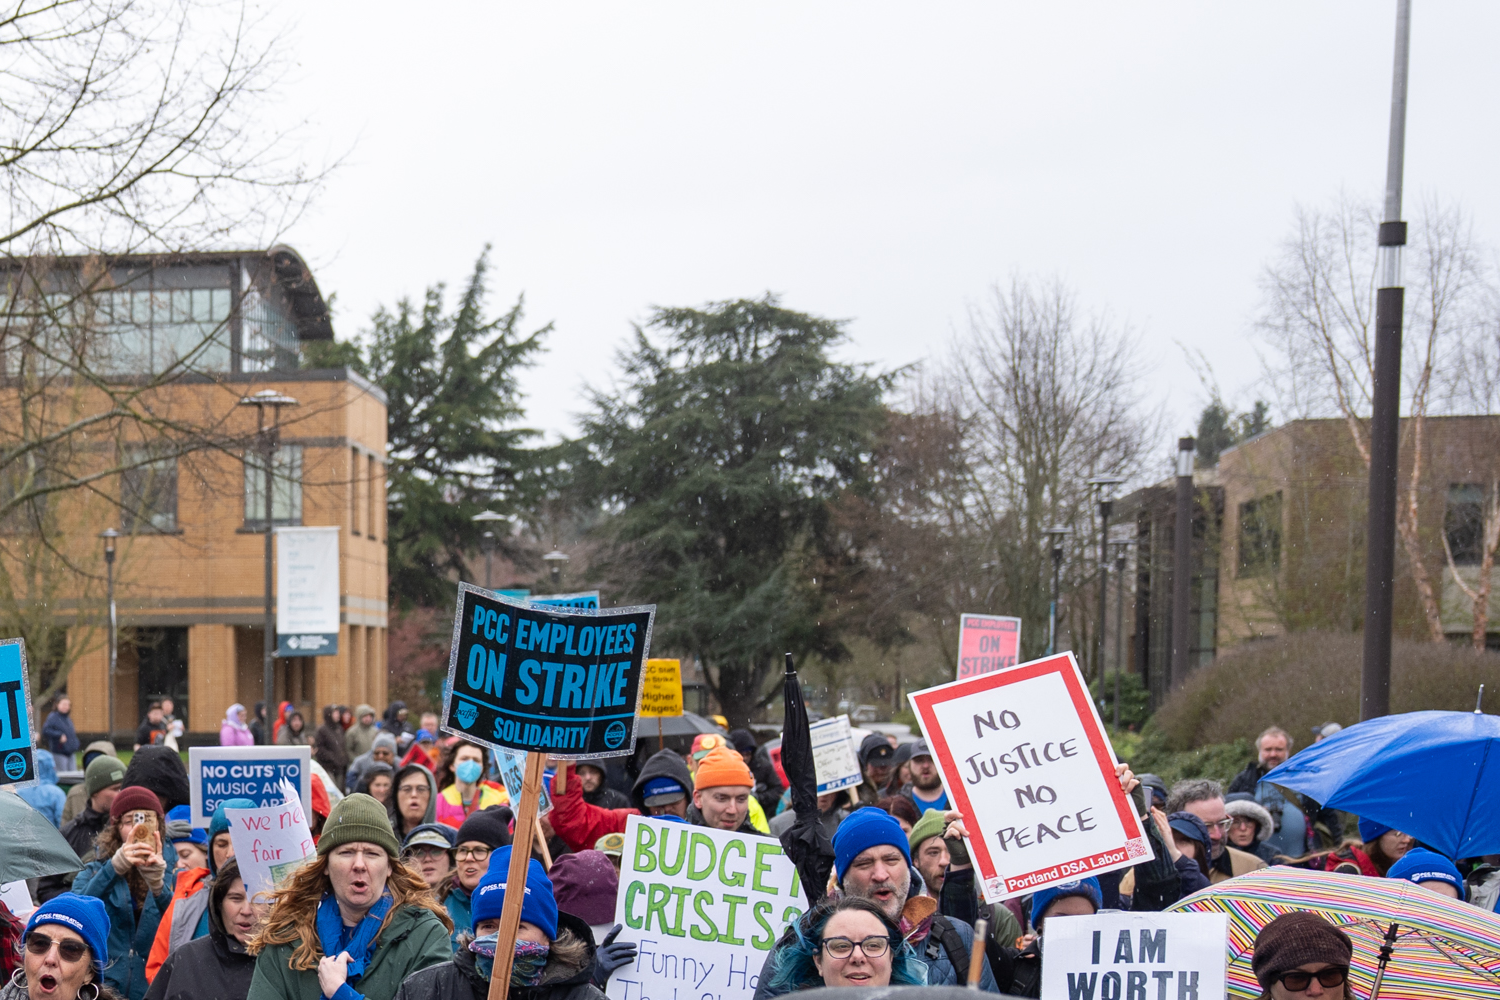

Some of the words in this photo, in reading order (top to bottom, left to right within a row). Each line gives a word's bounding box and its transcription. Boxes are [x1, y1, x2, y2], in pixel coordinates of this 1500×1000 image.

[472, 604, 510, 644] PCC
[515, 618, 637, 657] EMPLOYEES
[980, 635, 1001, 653] ON
[466, 643, 508, 699] ON
[515, 658, 632, 710] STRIKE
[961, 656, 1016, 675] STRIKE
[641, 704, 678, 714] Wages!
[642, 692, 675, 702] Higher
[493, 717, 590, 749] SOLIDARITY
[973, 709, 1021, 739] NO
[202, 765, 228, 778] NO
[230, 765, 274, 778] CUTS
[278, 764, 300, 777] TO
[965, 738, 1078, 786] JUSTICE
[207, 782, 257, 795] MUSIC
[262, 782, 296, 794] AN
[1013, 784, 1057, 809] NO
[995, 807, 1098, 852] PEACE
[251, 839, 283, 863] fair
[1008, 866, 1060, 891] Portland
[1060, 859, 1089, 877] DSA
[1090, 850, 1126, 868] Labor
[1091, 930, 1101, 965] I
[1113, 929, 1167, 964] AM
[636, 939, 714, 990] Funny
